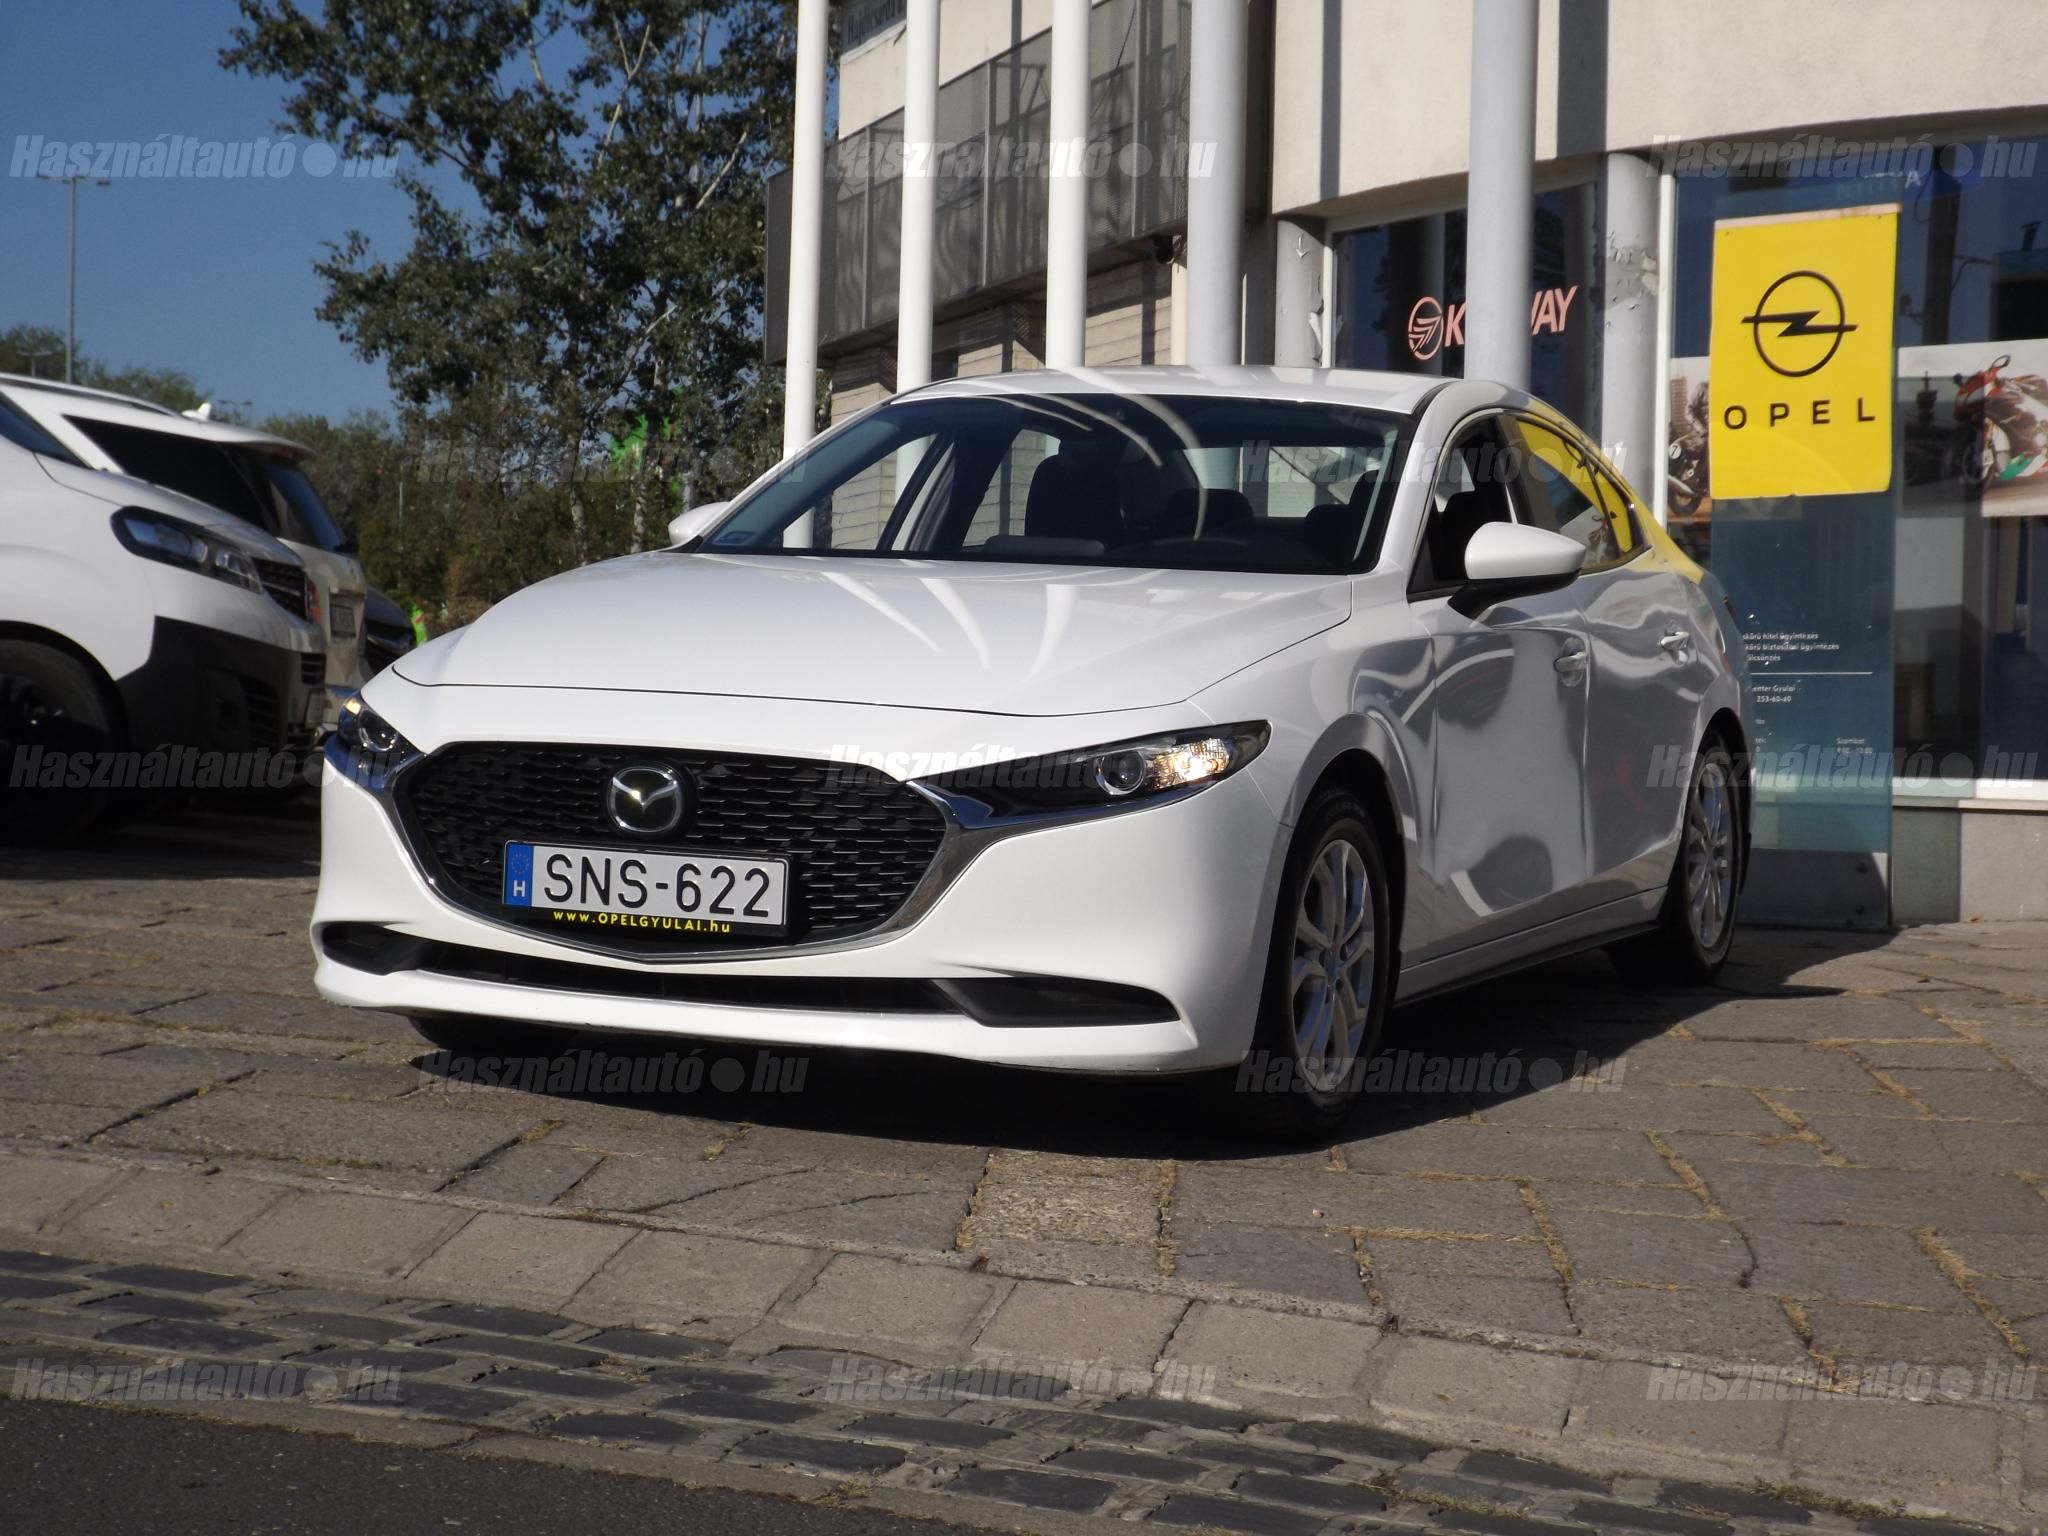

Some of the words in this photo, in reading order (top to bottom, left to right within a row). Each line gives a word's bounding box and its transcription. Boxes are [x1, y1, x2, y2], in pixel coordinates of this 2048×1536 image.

[1445, 285, 1578, 347] KAY
[1724, 398, 1875, 430] OPEL
[512, 879, 527, 898] H
[544, 853, 770, 918] SNS-622
[553, 910, 731, 934] www.OPELGYULAI.hu
